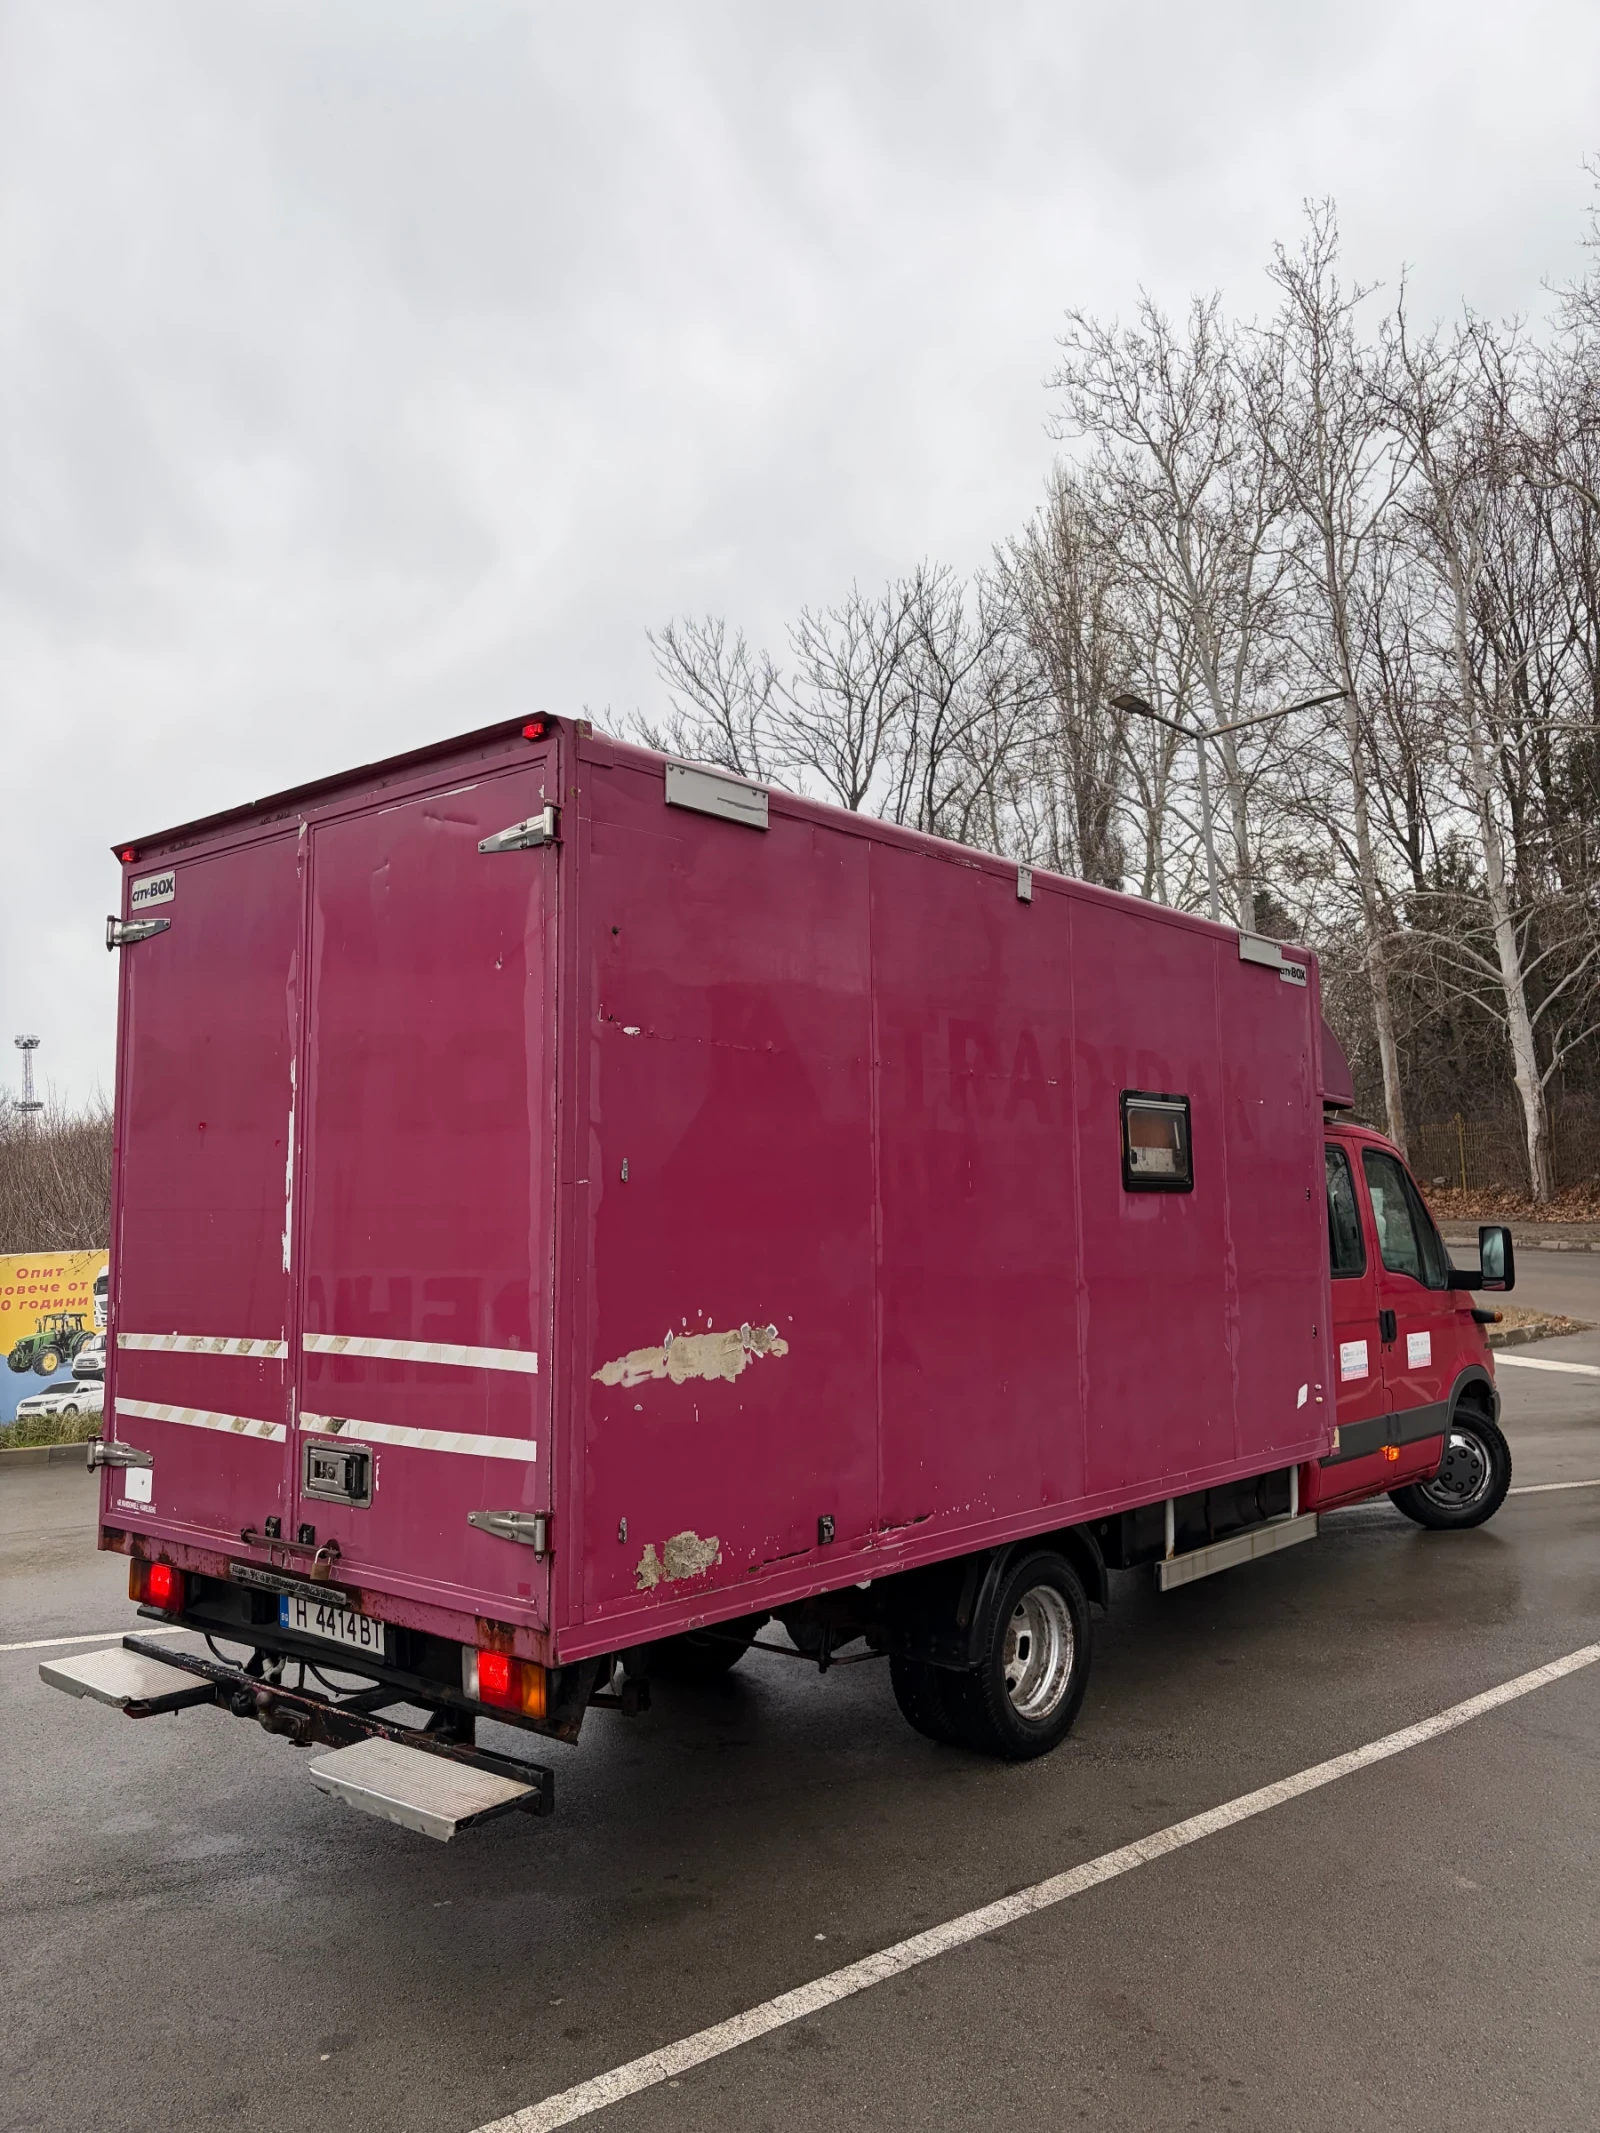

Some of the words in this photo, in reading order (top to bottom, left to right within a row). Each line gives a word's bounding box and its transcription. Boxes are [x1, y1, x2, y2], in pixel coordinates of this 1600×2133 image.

[16, 1267, 65, 1279] Опит
[68, 1281, 89, 1291] от
[19, 1296, 89, 1310] години
[281, 1612, 289, 1622] BG
